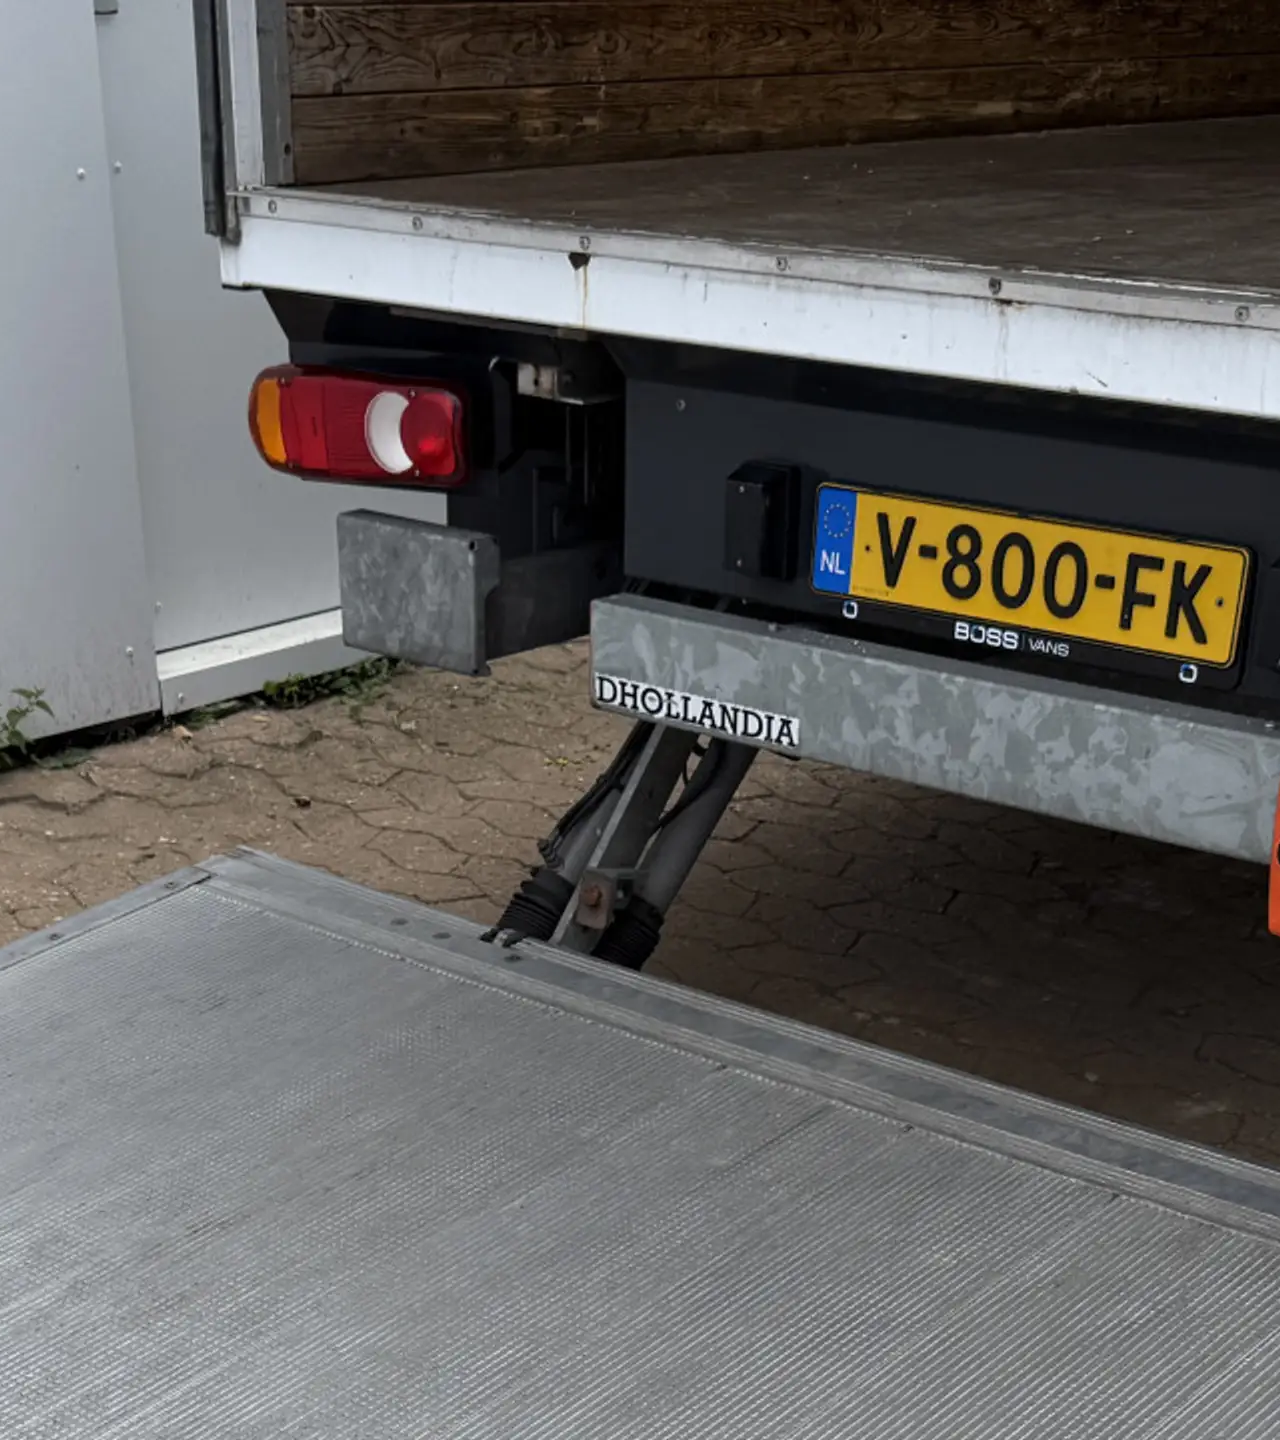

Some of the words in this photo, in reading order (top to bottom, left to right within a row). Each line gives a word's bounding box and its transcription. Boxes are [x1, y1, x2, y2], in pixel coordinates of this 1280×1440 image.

[820, 549, 846, 575] NL
[876, 511, 1213, 645] V-800-FK
[954, 621, 1019, 650] BOSS
[1028, 637, 1070, 658] VANS
[596, 675, 796, 748] DHOLLANDIA
